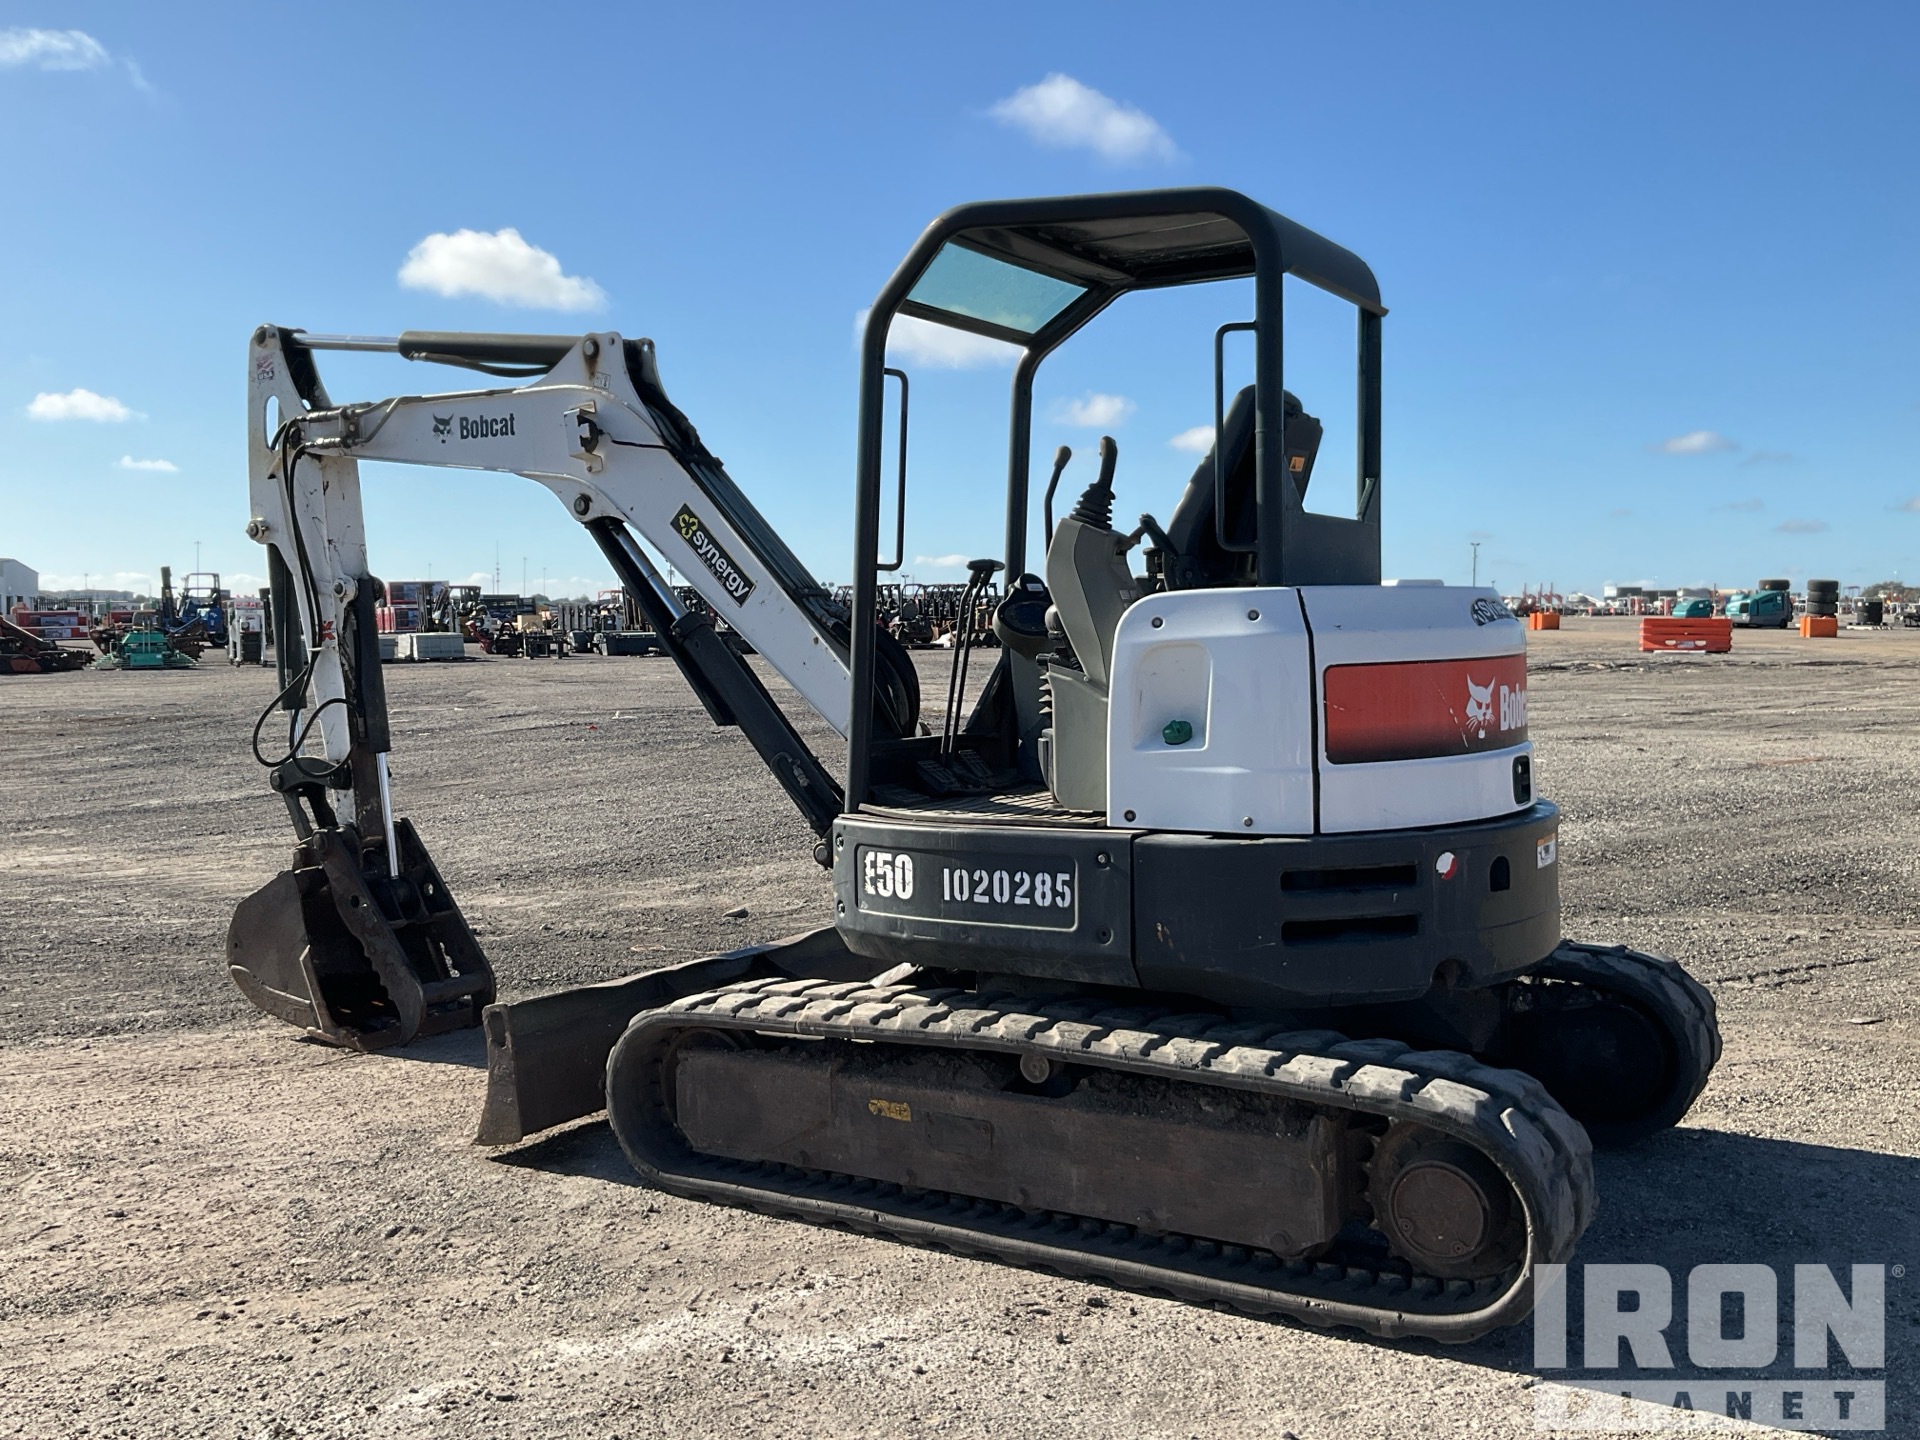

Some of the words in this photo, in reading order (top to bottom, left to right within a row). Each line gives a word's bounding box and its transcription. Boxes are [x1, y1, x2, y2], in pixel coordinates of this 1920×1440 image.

[459, 413, 516, 440] Bobcat
[692, 531, 750, 598] synergy
[864, 851, 914, 900] E50
[943, 868, 1071, 908] 1020285
